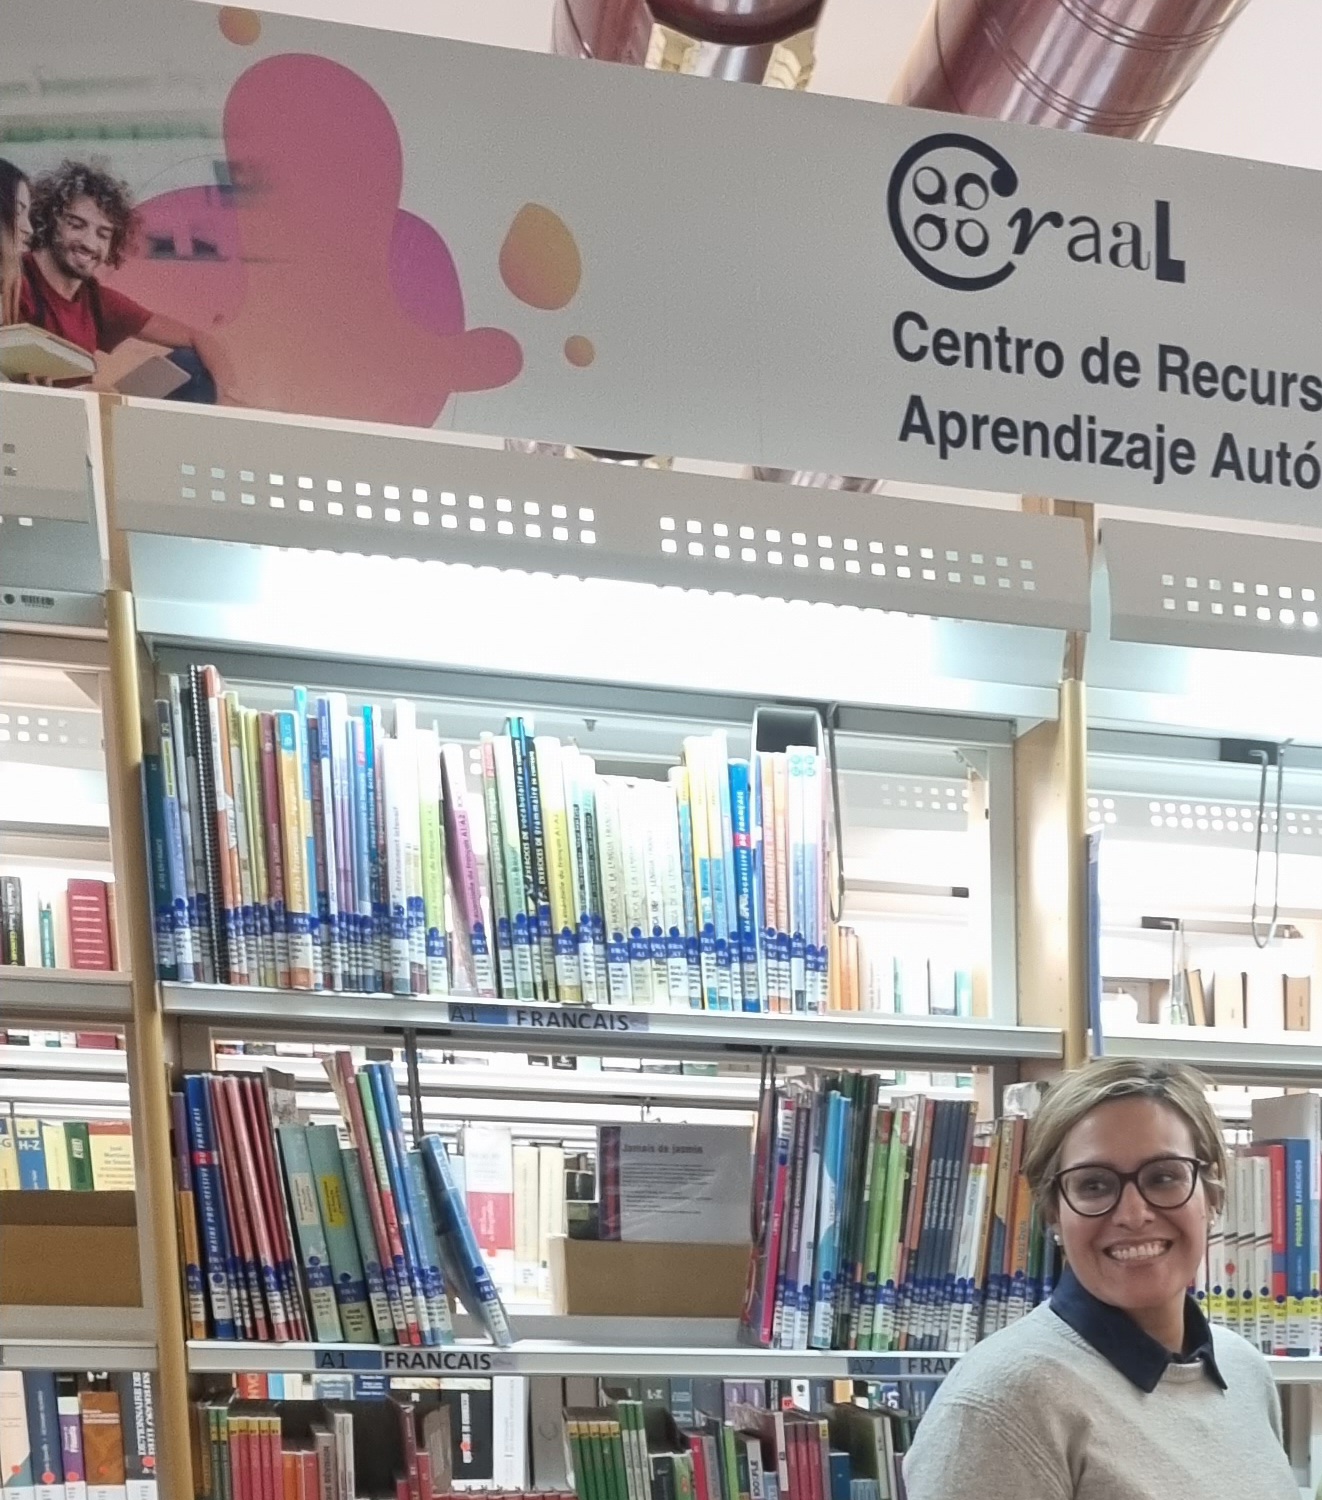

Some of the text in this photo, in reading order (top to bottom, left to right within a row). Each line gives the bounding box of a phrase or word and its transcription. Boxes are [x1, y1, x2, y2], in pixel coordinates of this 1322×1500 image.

[892, 309, 1065, 380] Centro
[1080, 335, 1141, 389] de
[898, 394, 1196, 485] Aprendizaje
[451, 1006, 477, 1022] A1
[19, 1140, 41, 1150] H-Z
[322, 1352, 349, 1370] A1
